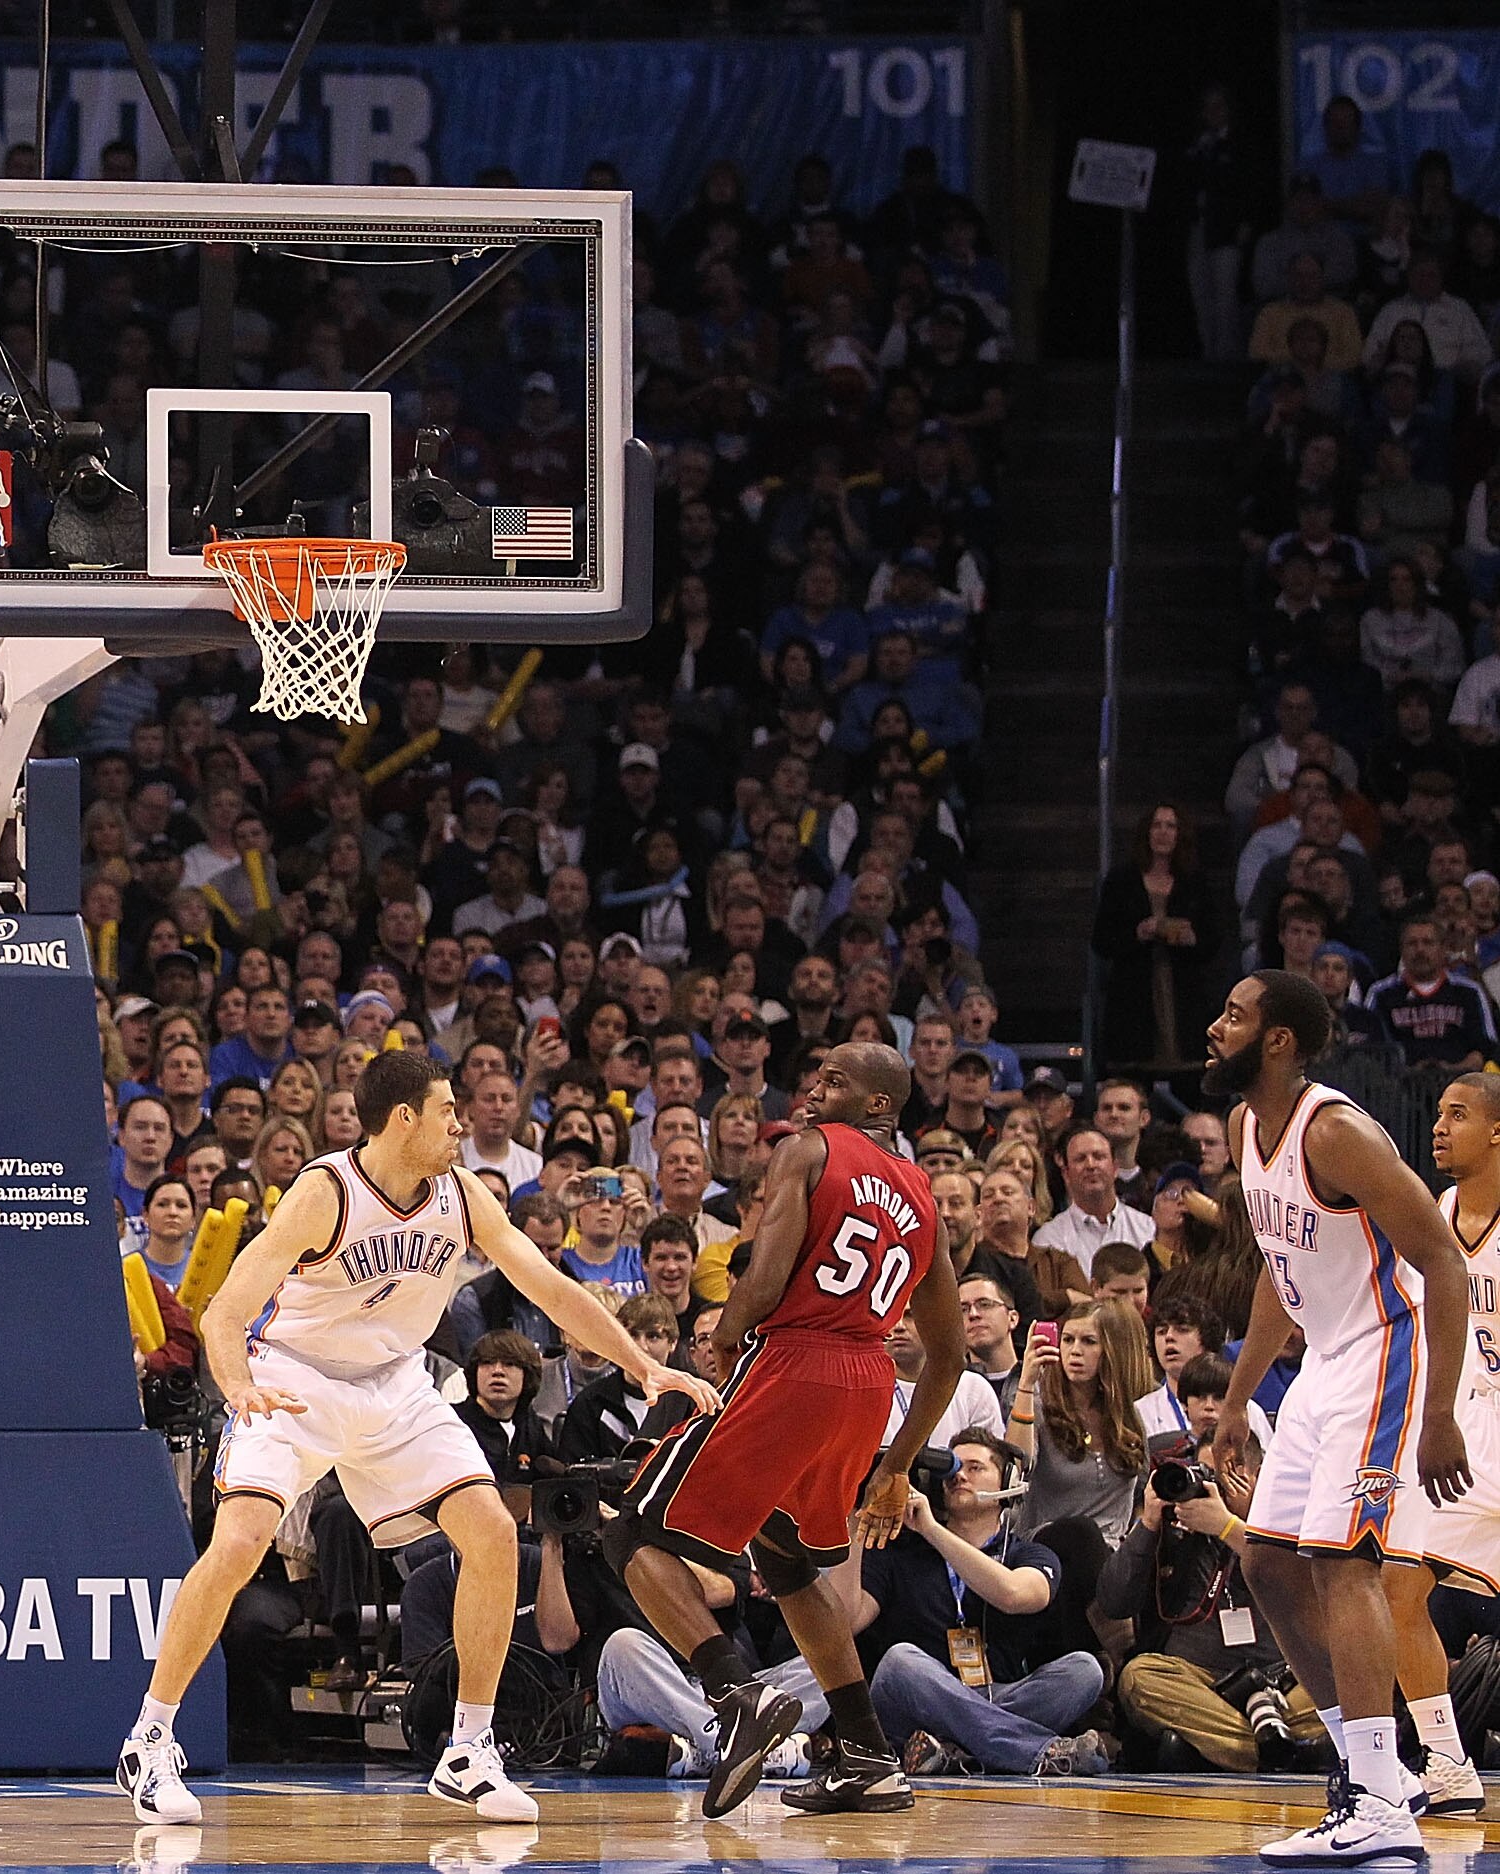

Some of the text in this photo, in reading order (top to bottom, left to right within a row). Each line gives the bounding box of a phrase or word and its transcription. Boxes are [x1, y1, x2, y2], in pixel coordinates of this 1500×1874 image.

[828, 47, 966, 118] 101
[1300, 43, 1461, 113] 102
[850, 1174, 921, 1238] ANTHONY
[1246, 1188, 1318, 1252] UNDER
[335, 1231, 459, 1286] THUNDER
[814, 1214, 912, 1319] 50
[1353, 1476, 1391, 1496] OKC
[1208, 1570, 1223, 1598] Canon
[77, 1578, 183, 1661] TV
